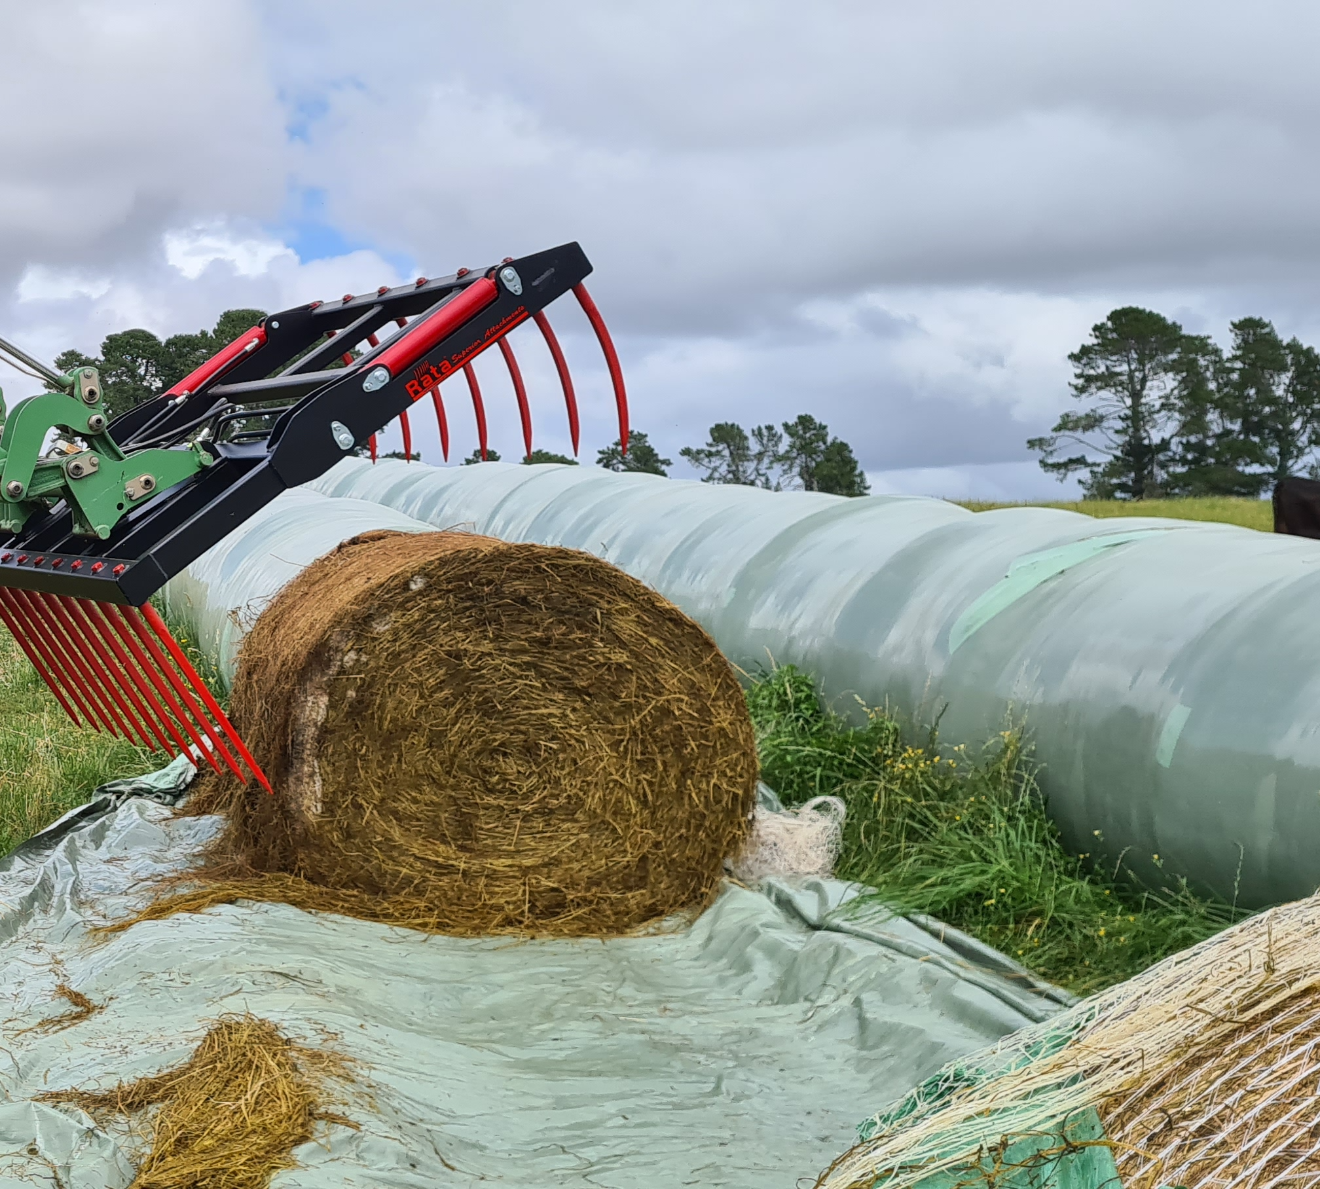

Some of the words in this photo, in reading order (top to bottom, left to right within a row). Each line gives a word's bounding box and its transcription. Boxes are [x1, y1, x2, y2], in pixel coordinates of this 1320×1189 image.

[404, 360, 452, 398] Rata
[451, 339, 481, 364] Superior
[483, 305, 526, 340] Attachments
